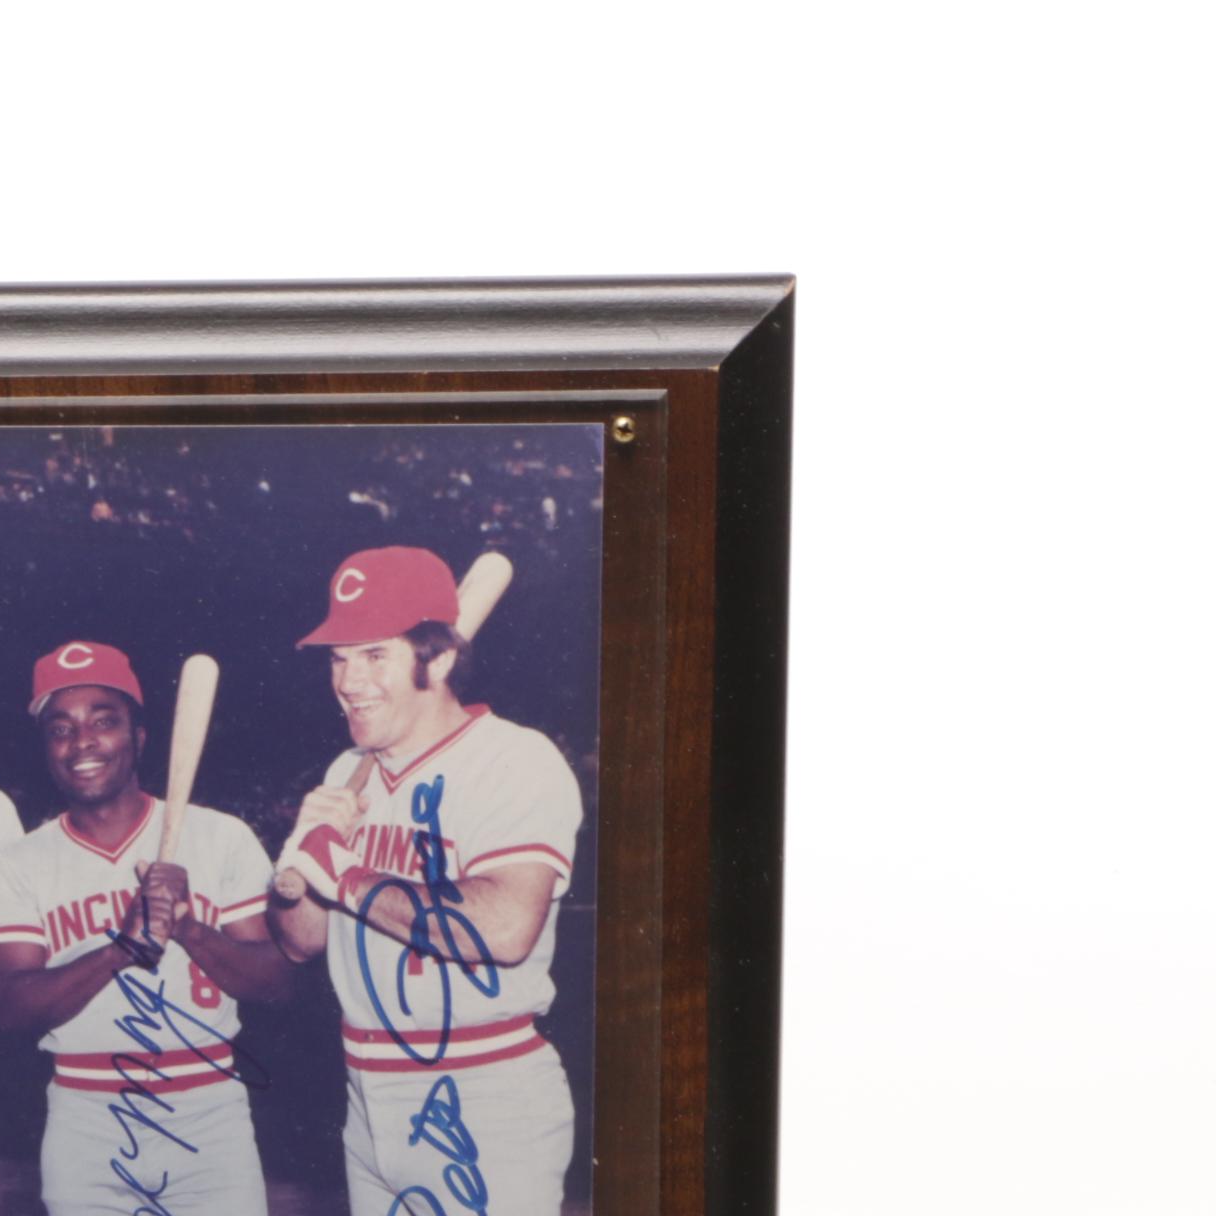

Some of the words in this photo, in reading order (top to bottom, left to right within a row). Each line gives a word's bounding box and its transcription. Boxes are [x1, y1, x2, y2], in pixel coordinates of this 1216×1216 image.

[335, 567, 365, 602] C
[57, 643, 93, 669] C
[189, 960, 221, 1009] 8
